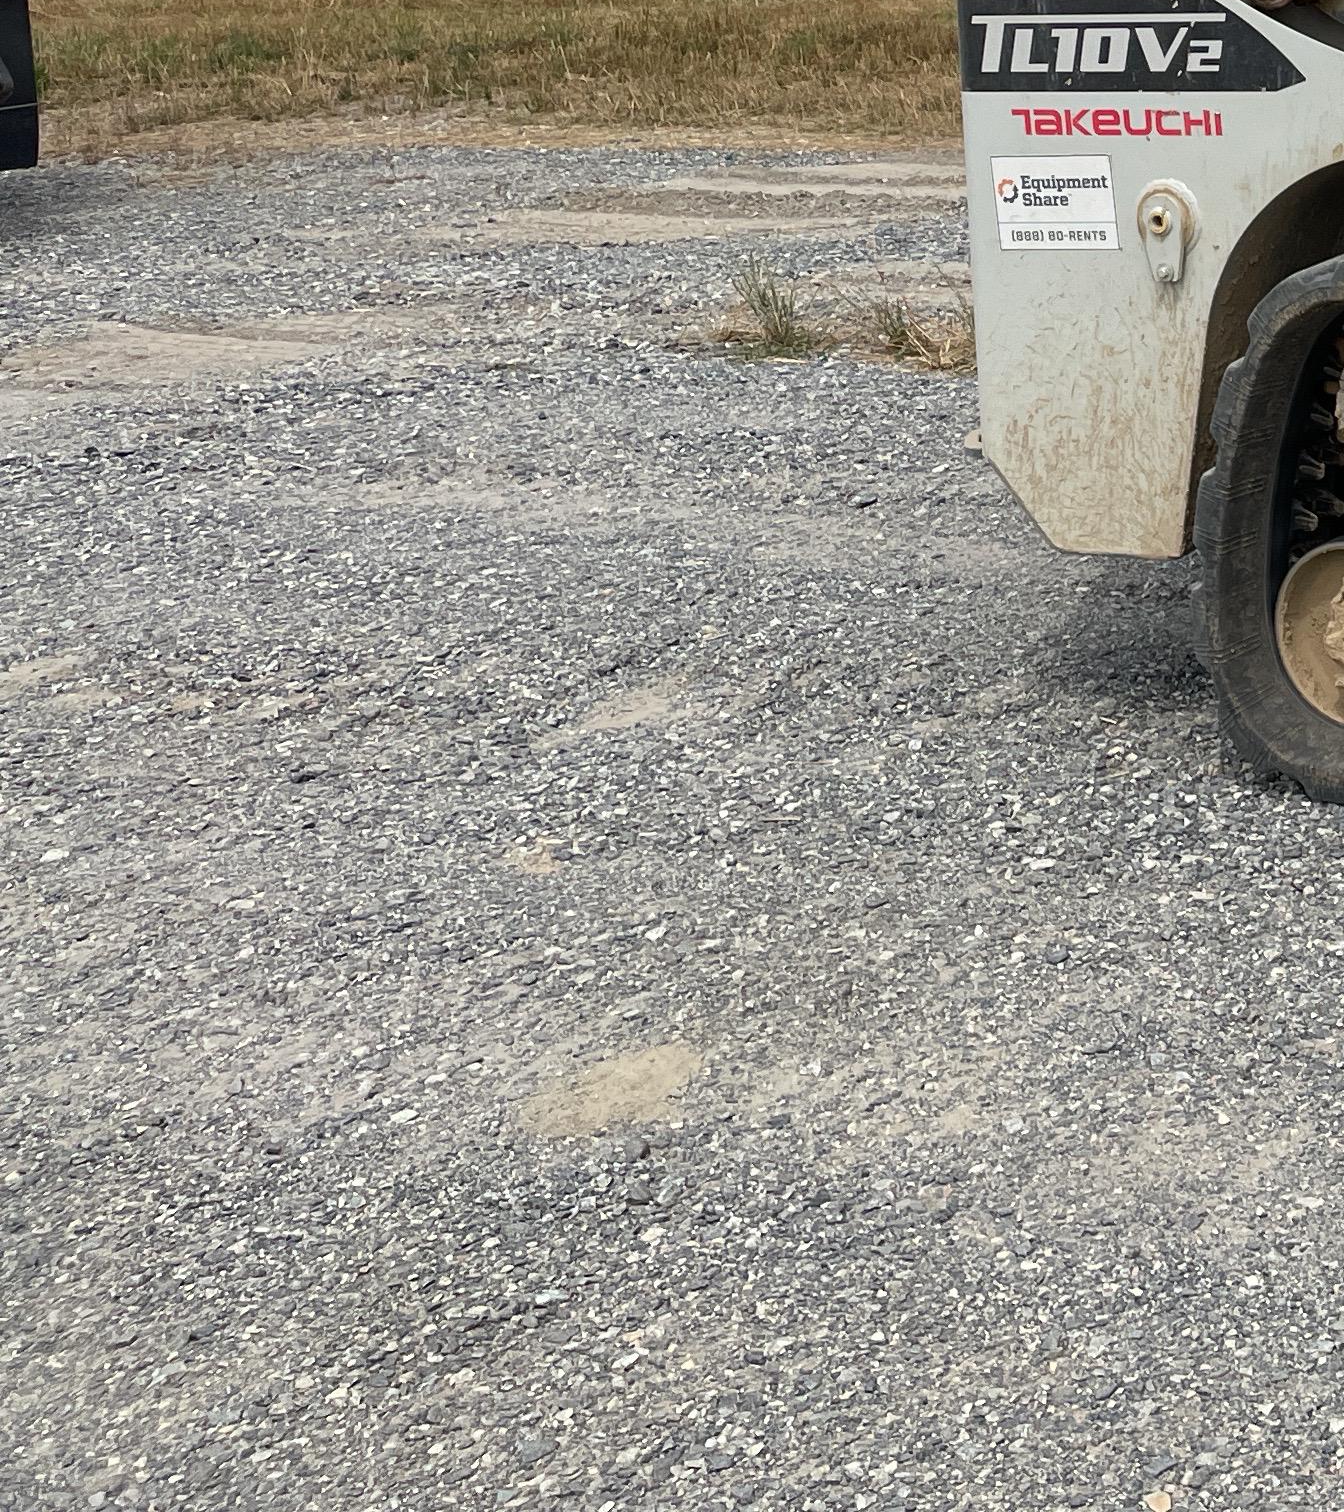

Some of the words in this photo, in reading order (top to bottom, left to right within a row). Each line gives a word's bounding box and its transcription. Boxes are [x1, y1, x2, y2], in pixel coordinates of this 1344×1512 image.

[970, 12, 1227, 74] TL10V2
[1011, 107, 1224, 137] TAKEUCHI
[1020, 175, 1109, 193] Equipment
[1022, 192, 1070, 207] Share
[1011, 230, 1045, 242] (888)
[1047, 230, 1107, 242] 80-RENTS
